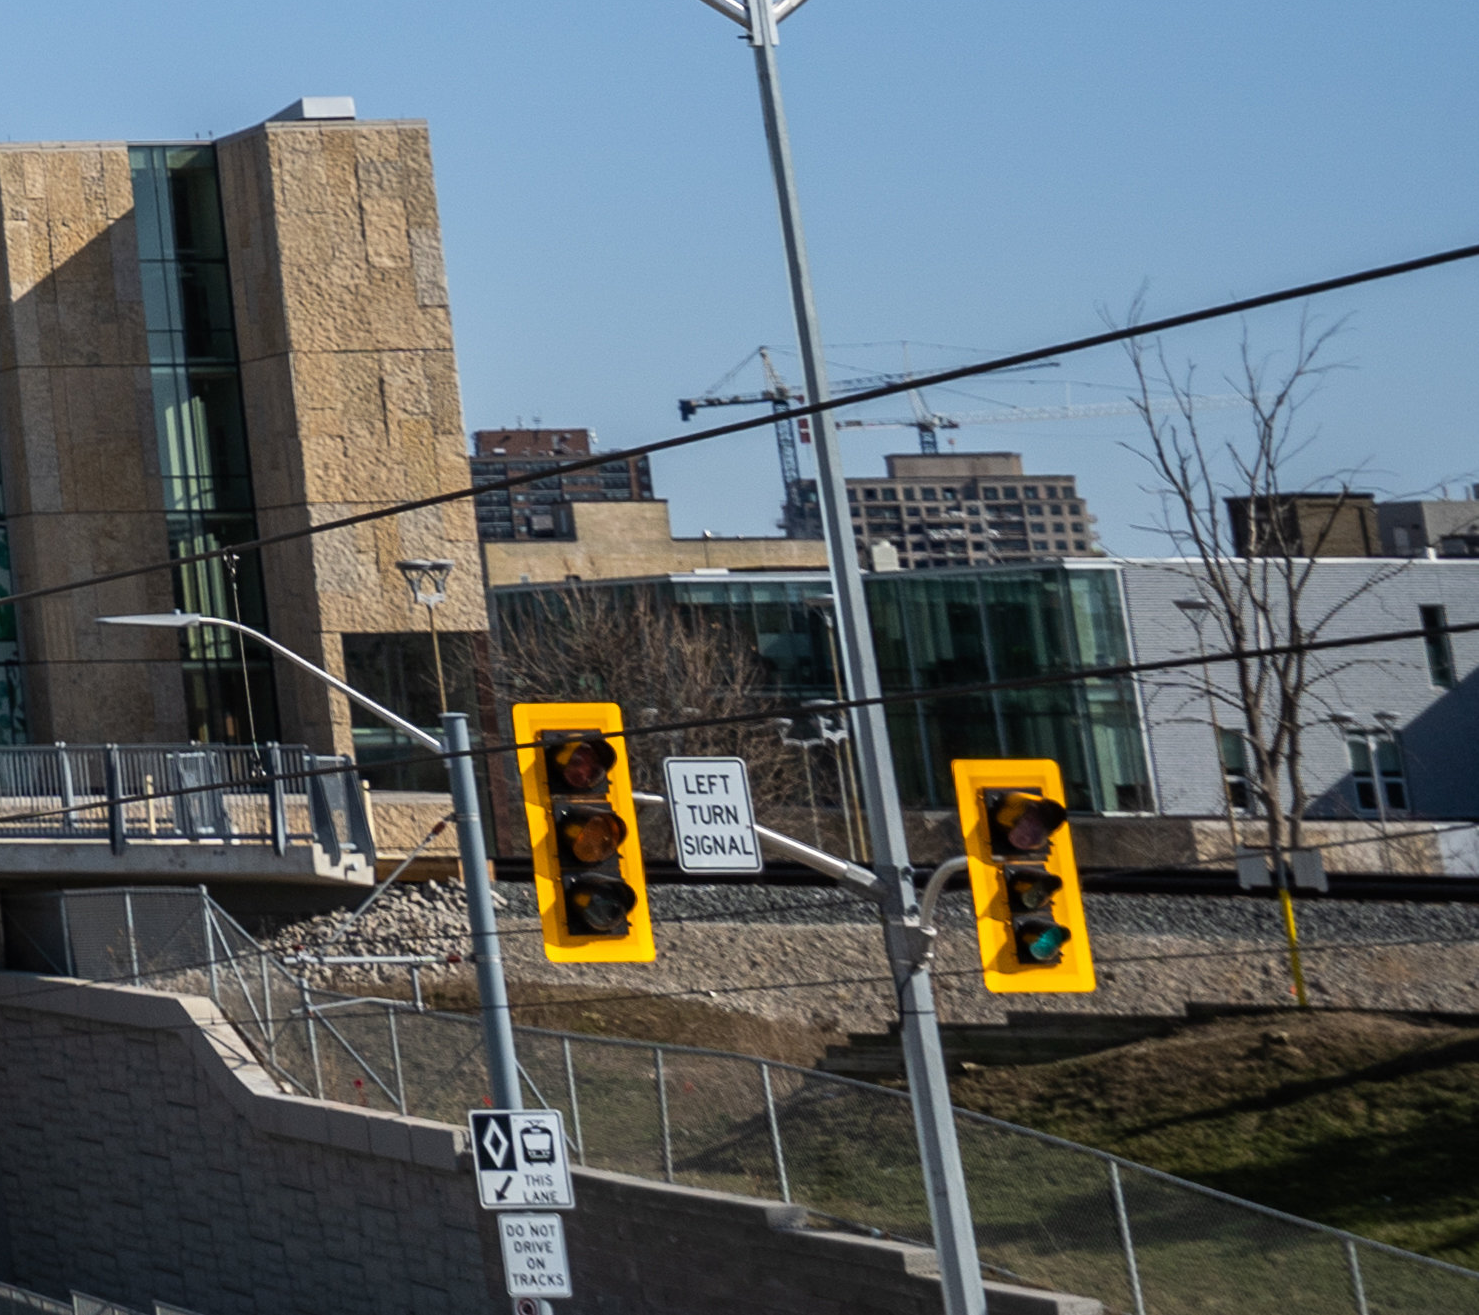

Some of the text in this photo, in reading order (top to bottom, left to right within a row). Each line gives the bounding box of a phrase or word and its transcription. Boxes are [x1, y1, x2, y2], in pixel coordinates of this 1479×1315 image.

[683, 774, 730, 795] LEFT
[686, 804, 739, 825] TURN
[683, 835, 754, 856] SIGNAL
[524, 1174, 554, 1187] THIS
[523, 1190, 559, 1204] LANE
[505, 1224, 555, 1237] DO NOT
[513, 1240, 554, 1254] DRIVE
[526, 1257, 546, 1270] ON
[512, 1273, 565, 1287] TRACKS
